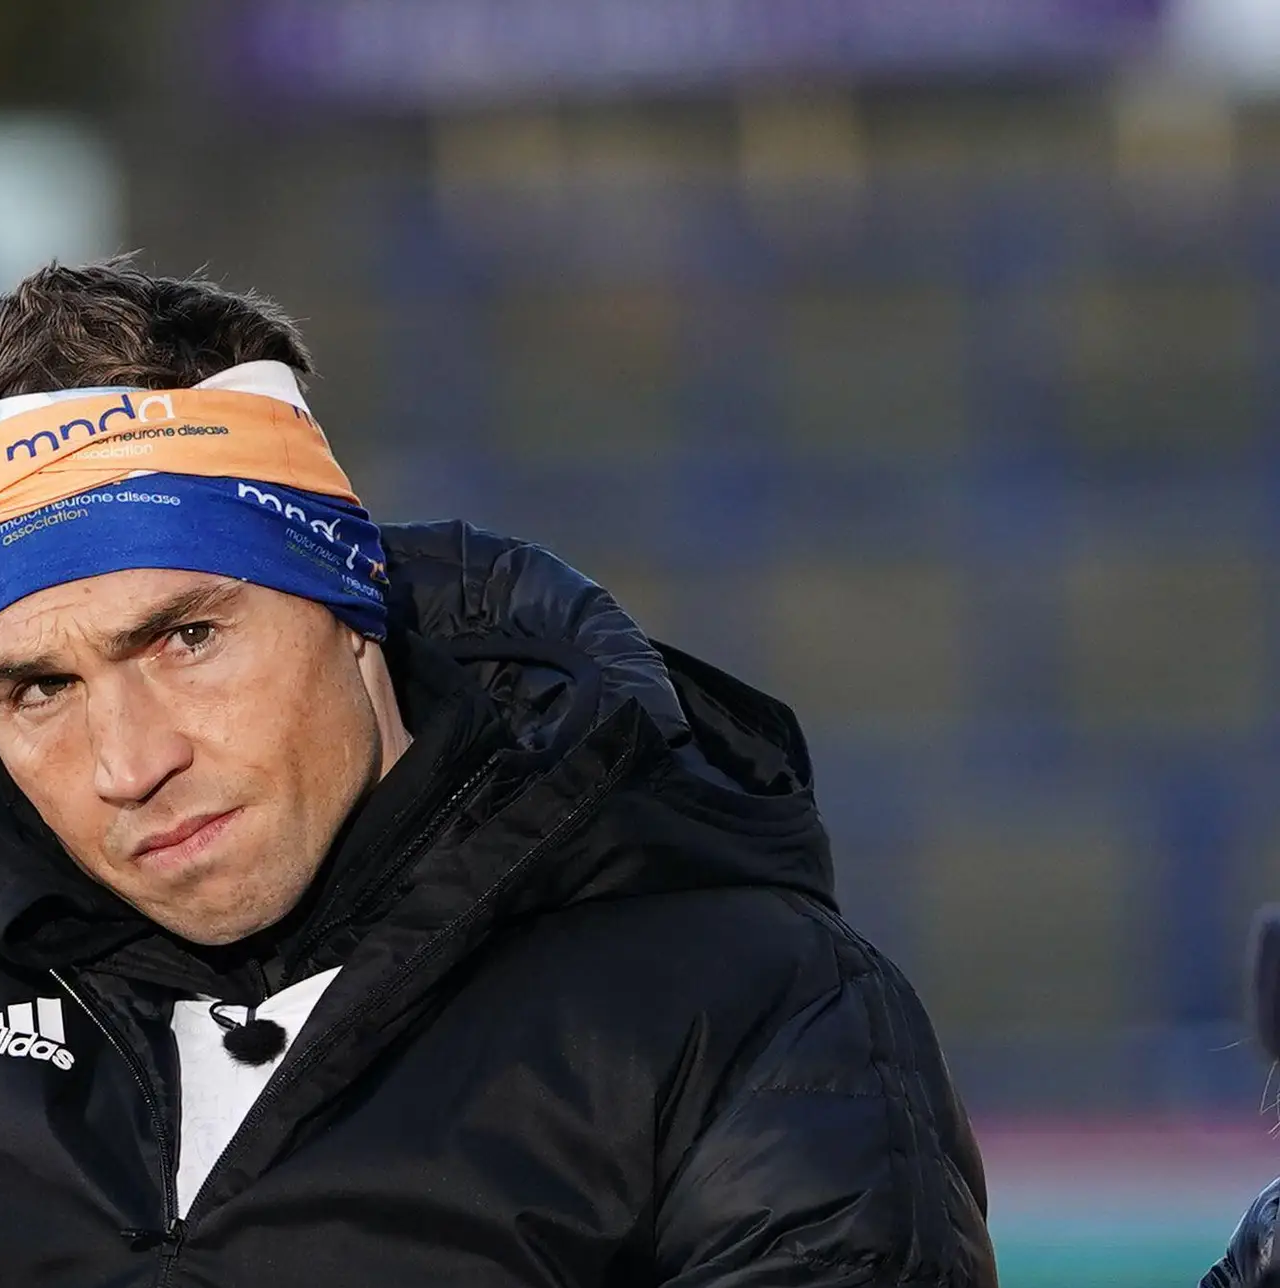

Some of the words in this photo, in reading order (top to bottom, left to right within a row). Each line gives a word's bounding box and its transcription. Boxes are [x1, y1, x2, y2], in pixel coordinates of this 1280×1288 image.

[113, 427, 175, 443] neurone
[177, 425, 229, 436] disease
[116, 491, 181, 506] disease
[2, 508, 89, 546] association
